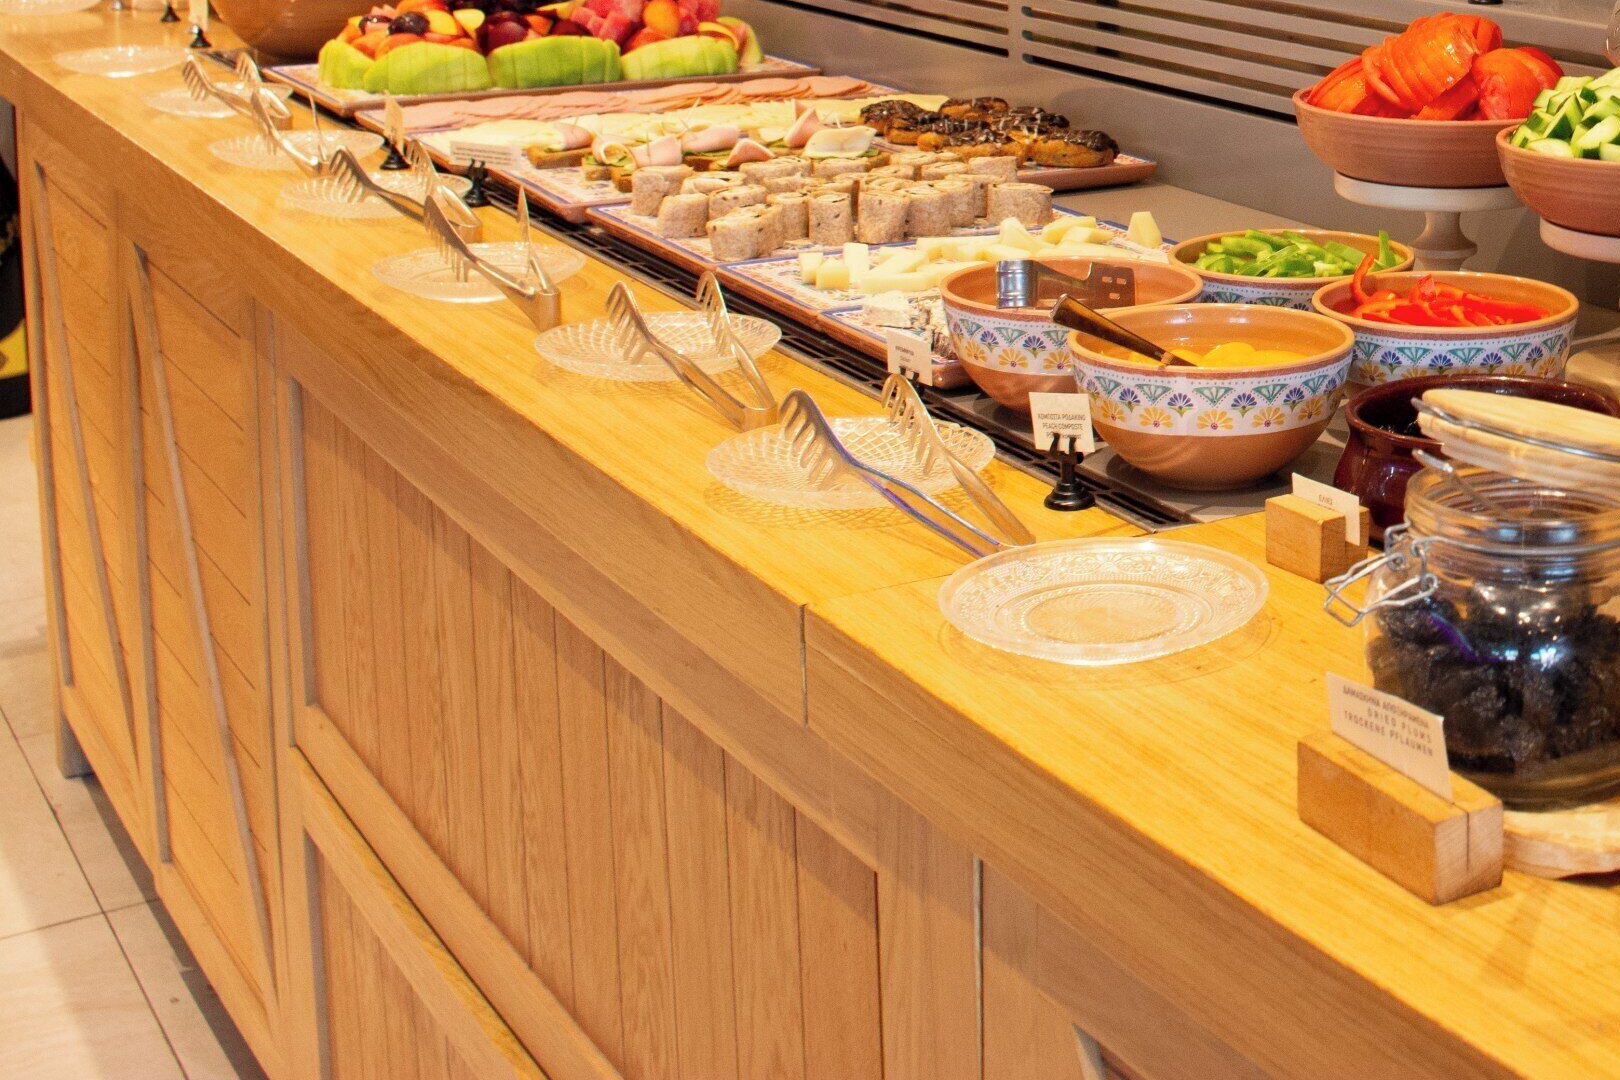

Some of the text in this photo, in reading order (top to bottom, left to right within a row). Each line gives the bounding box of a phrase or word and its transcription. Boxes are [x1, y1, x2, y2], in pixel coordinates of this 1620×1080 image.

[1344, 710, 1433, 757] TROCKENE PFLAUMEN
[1367, 707, 1432, 744] DRIED PLUMS
